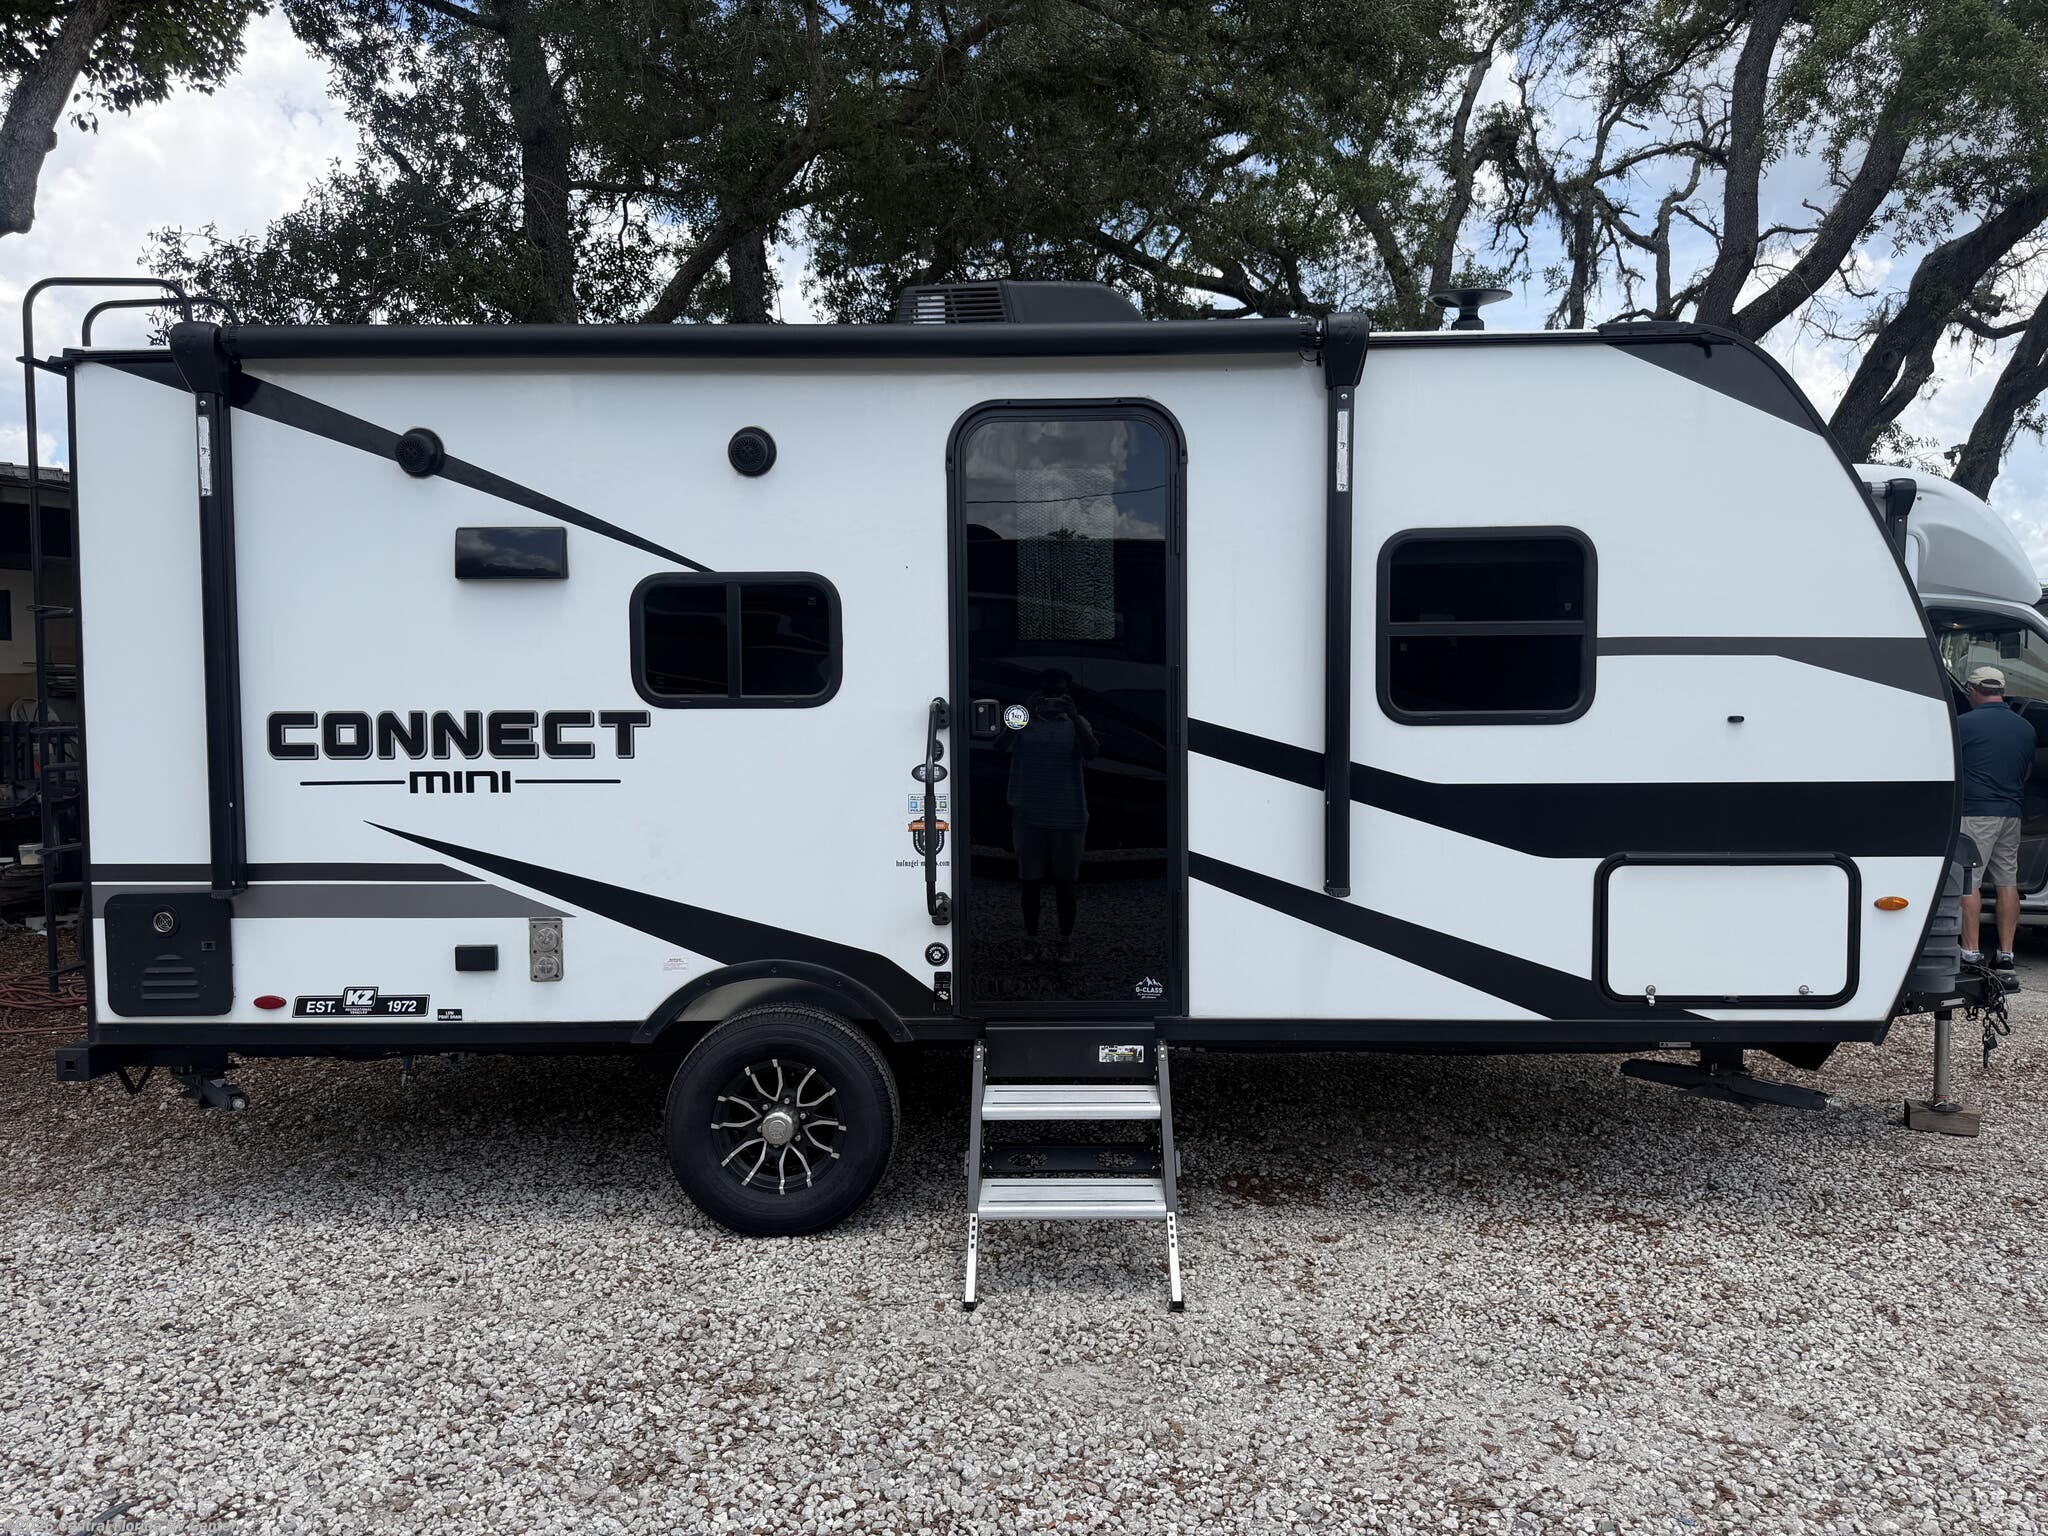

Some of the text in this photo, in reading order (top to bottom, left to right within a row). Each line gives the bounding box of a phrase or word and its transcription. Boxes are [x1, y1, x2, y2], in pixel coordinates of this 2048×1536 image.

[265, 710, 651, 760] CONNECT
[346, 990, 375, 1005] KZ
[306, 1001, 336, 1013] EST.
[387, 1000, 417, 1012] 1972
